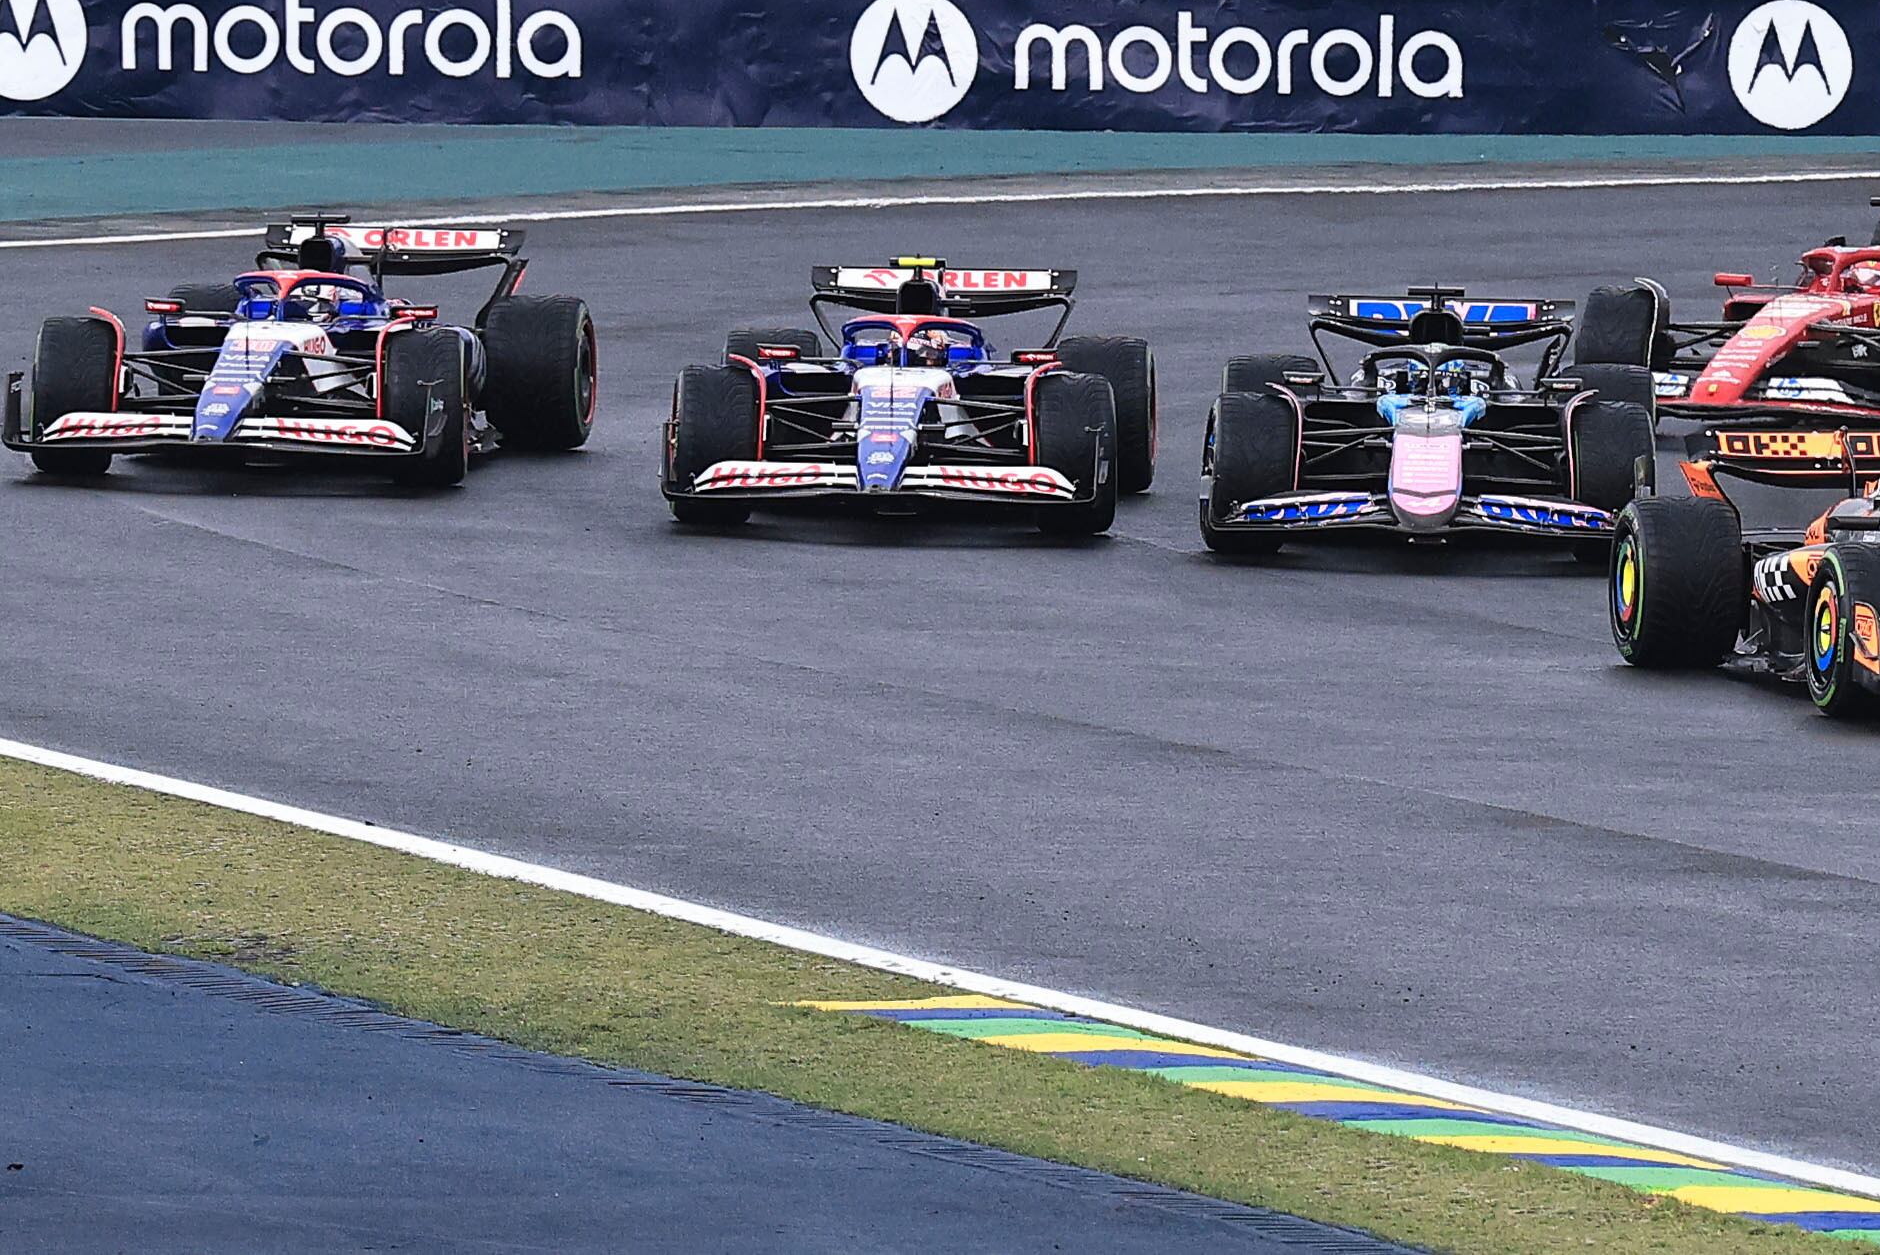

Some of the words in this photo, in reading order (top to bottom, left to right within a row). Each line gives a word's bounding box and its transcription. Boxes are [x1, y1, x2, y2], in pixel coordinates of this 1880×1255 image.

[1014, 11, 1464, 98] motorola
[363, 229, 478, 248] ORLEN
[276, 417, 397, 446] HUGO
[711, 464, 822, 486] HUGO
[939, 466, 1059, 493] HUGO
